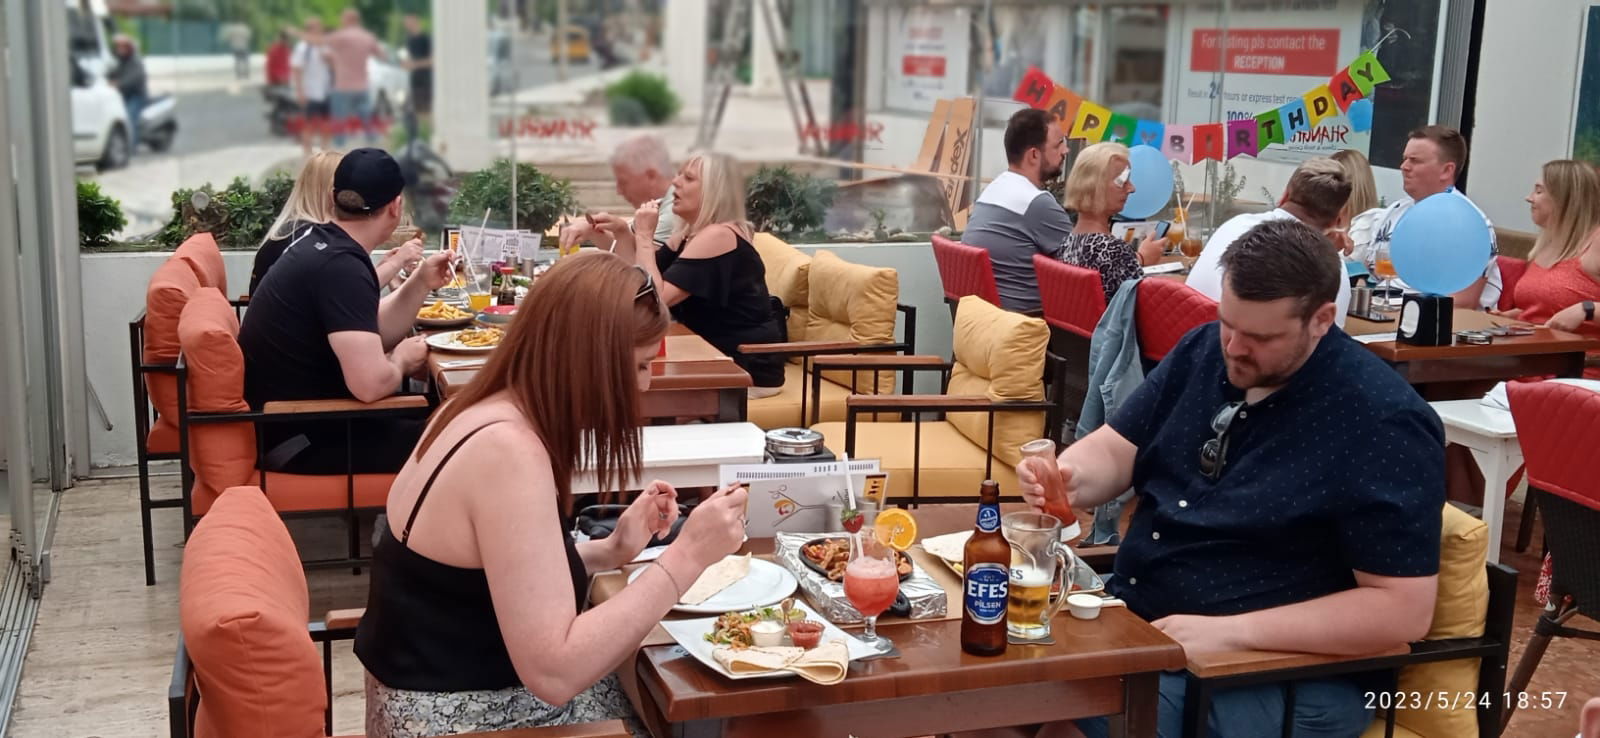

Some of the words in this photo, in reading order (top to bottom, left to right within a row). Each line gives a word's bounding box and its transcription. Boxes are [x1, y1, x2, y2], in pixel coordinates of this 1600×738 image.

[1201, 33, 1215, 48] For
[1216, 34, 1250, 53] tsting
[1251, 34, 1266, 53] pls
[1267, 35, 1306, 49] contact
[1308, 34, 1326, 49] the
[1233, 55, 1286, 70] RECEPTION
[1248, 94, 1272, 104] express
[1273, 93, 1285, 104] test
[1170, 62, 1375, 153] BIRTHDAY
[1009, 568, 1024, 581] ES
[967, 580, 1008, 599] EFES
